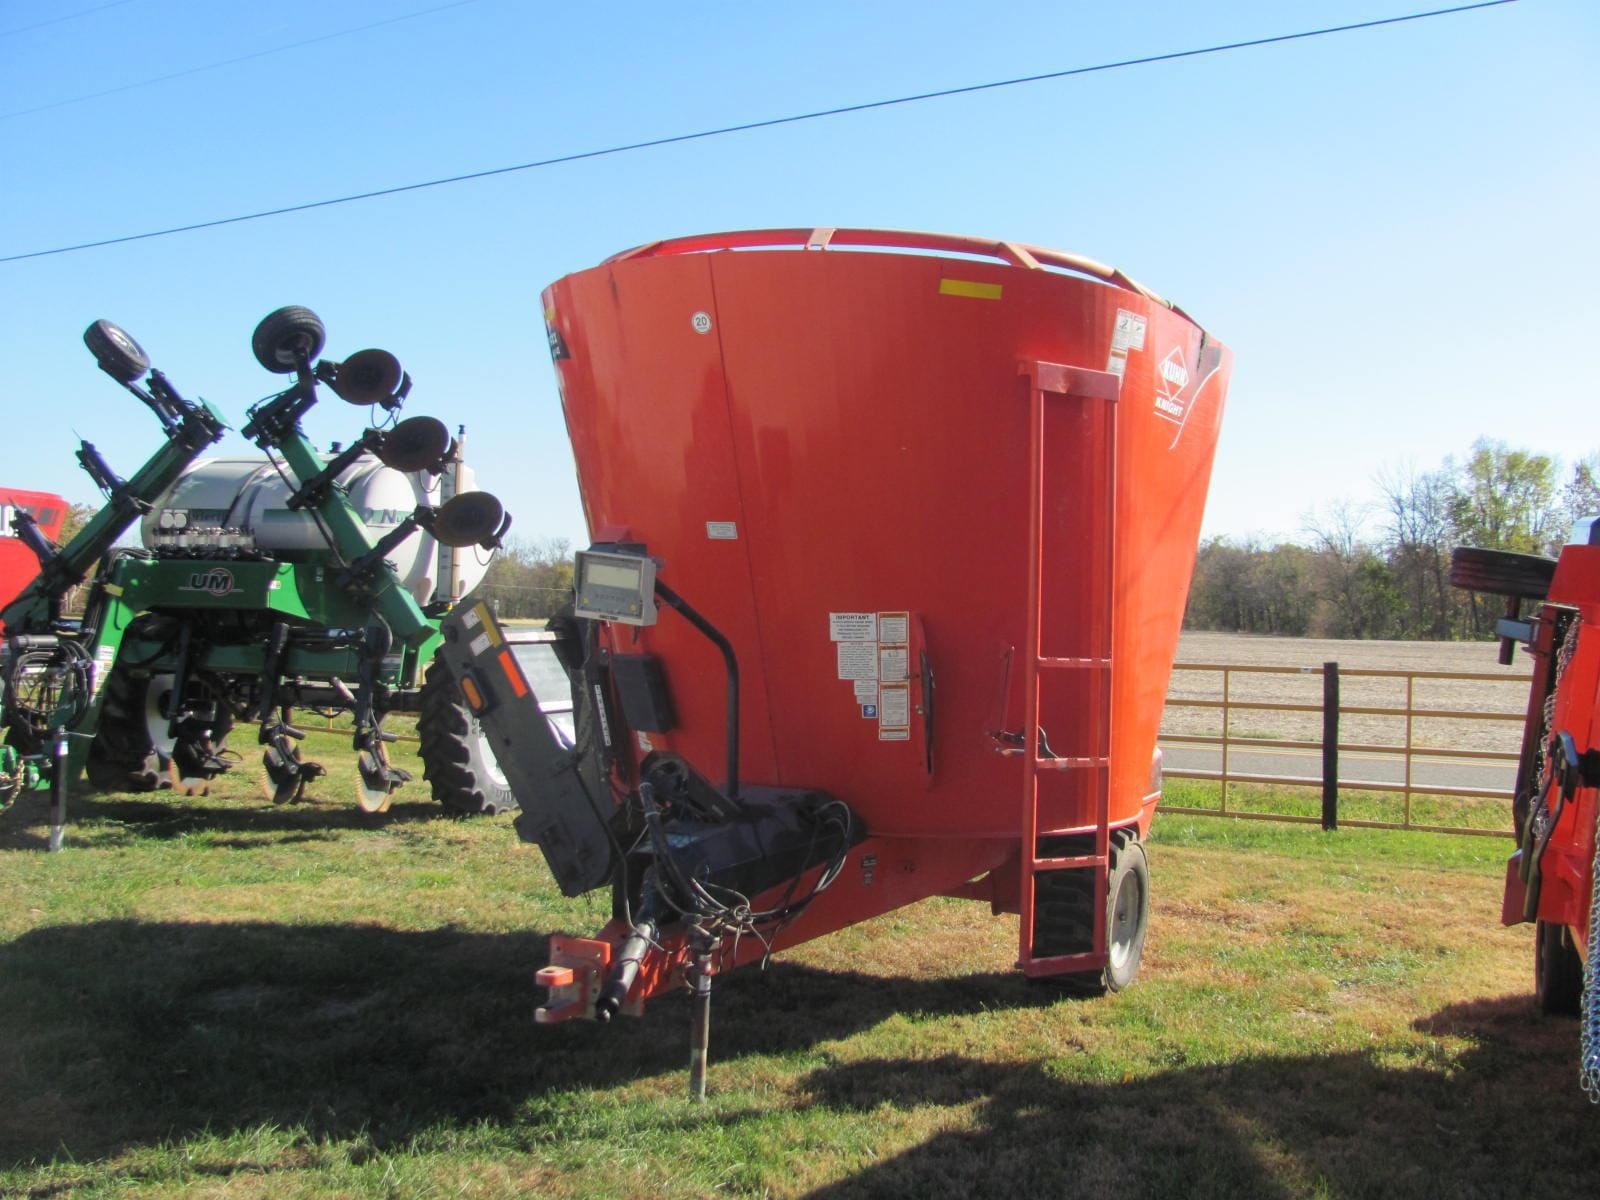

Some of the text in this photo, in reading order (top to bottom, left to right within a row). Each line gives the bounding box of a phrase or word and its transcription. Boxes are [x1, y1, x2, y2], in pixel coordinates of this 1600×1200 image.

[695, 316, 708, 327] 20
[1155, 396, 1183, 416] KNIGHT
[190, 573, 230, 590] UM
